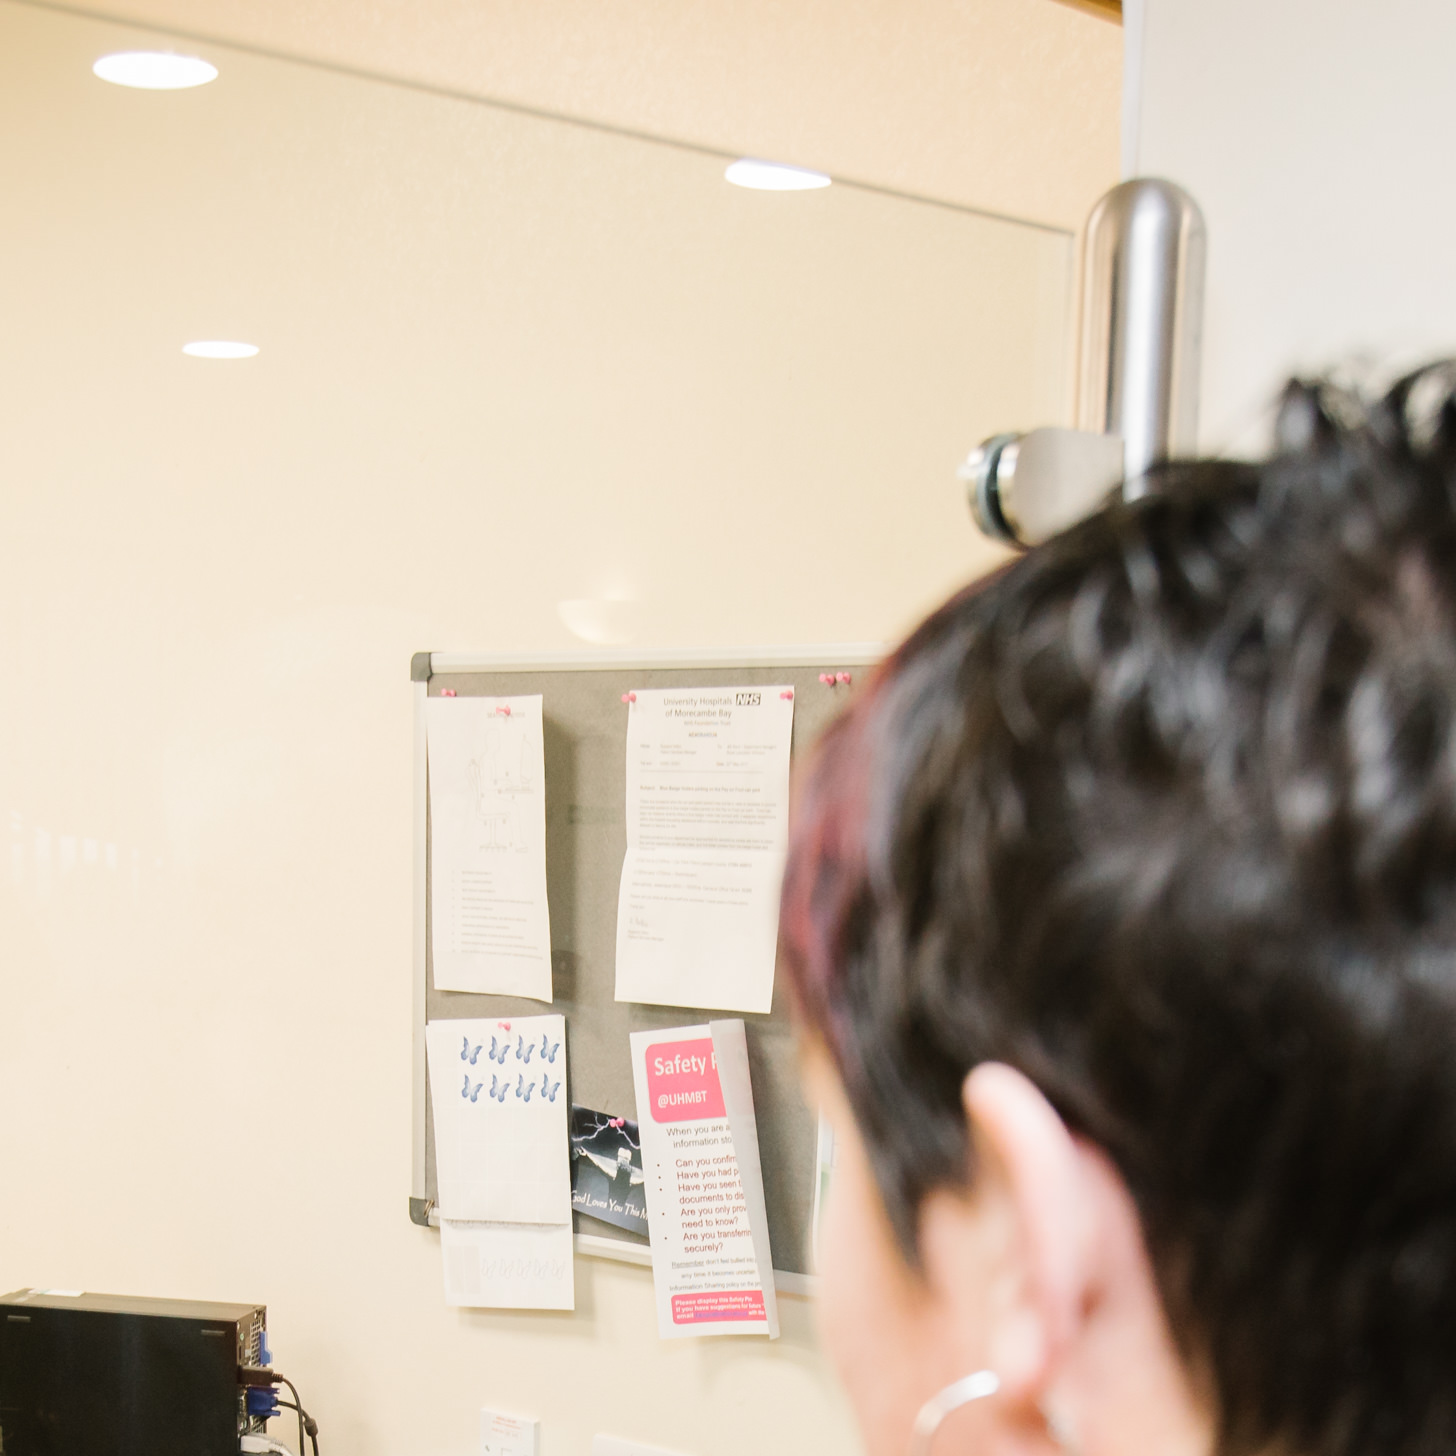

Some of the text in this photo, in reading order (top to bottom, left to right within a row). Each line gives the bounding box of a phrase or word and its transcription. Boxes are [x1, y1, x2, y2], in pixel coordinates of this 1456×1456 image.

[664, 693, 761, 708] University Hospitals NHS
[665, 709, 733, 719] of Morecambe Bay
[654, 1054, 706, 1076] Safety
[658, 1091, 707, 1108] @UHMBT
[666, 1128, 691, 1137] When
[694, 1127, 709, 1136] you
[673, 1136, 732, 1148] information sto
[675, 1158, 693, 1168] Can
[696, 1159, 710, 1168] you
[677, 1168, 739, 1180] Have you had p
[678, 1182, 700, 1192] Have
[703, 1182, 717, 1192] you
[719, 1181, 737, 1189] seen
[679, 1191, 745, 1204] documents to dis
[586, 1194, 607, 1209] Loves
[608, 1199, 623, 1213] You
[625, 1203, 640, 1216] This
[640, 1207, 649, 1221] M
[680, 1205, 746, 1217] Are you only prov
[681, 1216, 738, 1228] need to know?
[683, 1229, 751, 1241] Are you transferrin
[684, 1242, 723, 1253] securely?
[672, 1260, 705, 1269] Remember
[669, 1283, 703, 1291] Information
[697, 1298, 718, 1306] display
[710, 1303, 741, 1311] suggestions
